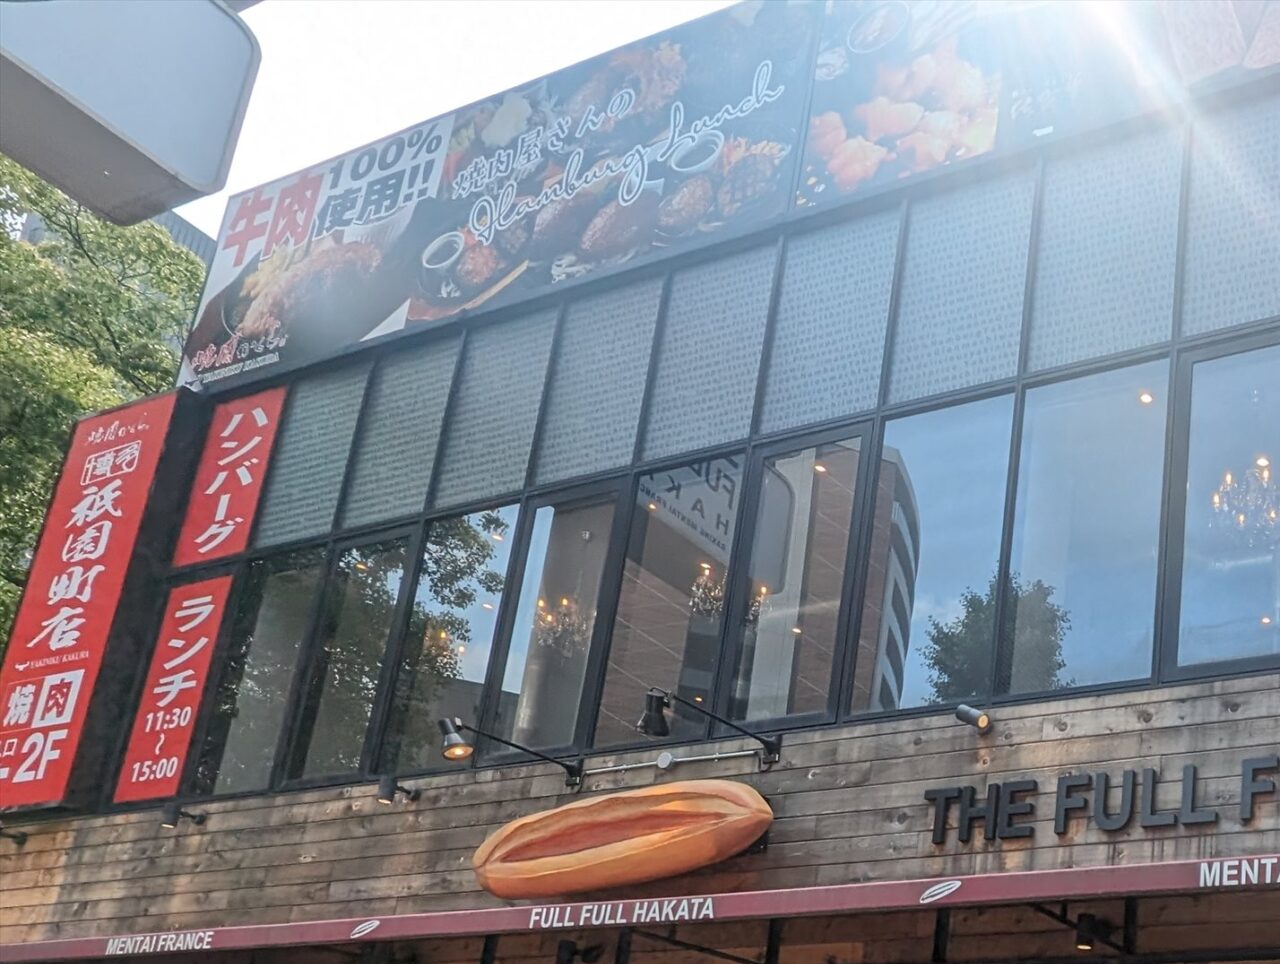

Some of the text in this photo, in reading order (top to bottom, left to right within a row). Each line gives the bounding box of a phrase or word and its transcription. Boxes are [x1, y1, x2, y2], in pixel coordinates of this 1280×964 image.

[452, 88, 636, 200] 焼肉屋さんの
[658, 59, 785, 162] Lunch
[329, 123, 443, 190] 100%
[222, 169, 324, 268] 牛肉
[195, 407, 269, 553] ハンバーグ
[27, 479, 122, 651] 祇園町店
[153, 595, 215, 708] ランチ
[3, 678, 73, 727] 焼肉
[145, 706, 192, 733] 11:30
[12, 729, 69, 783] 2F
[131, 756, 178, 783] 15:00
[924, 778, 1038, 845] THE
[1053, 764, 1217, 835] FULL
[105, 931, 215, 956] MENTAI FRANCE
[529, 897, 714, 929] FULL FULL HAKATA
